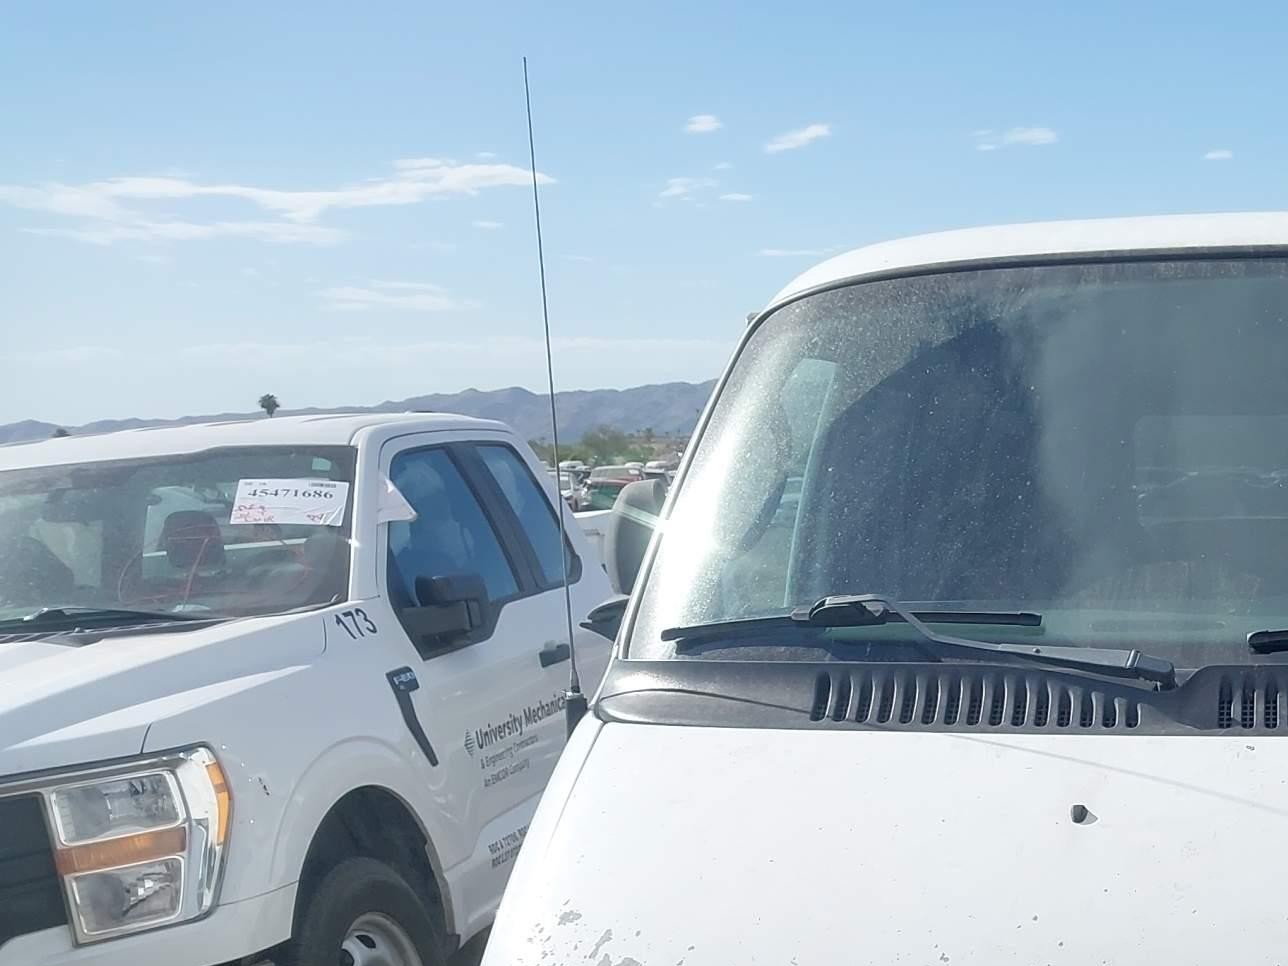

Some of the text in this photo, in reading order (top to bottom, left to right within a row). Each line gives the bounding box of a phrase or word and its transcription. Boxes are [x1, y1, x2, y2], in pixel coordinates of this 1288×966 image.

[247, 488, 334, 499] 45471686
[334, 608, 378, 640] 173
[475, 713, 523, 750] University
